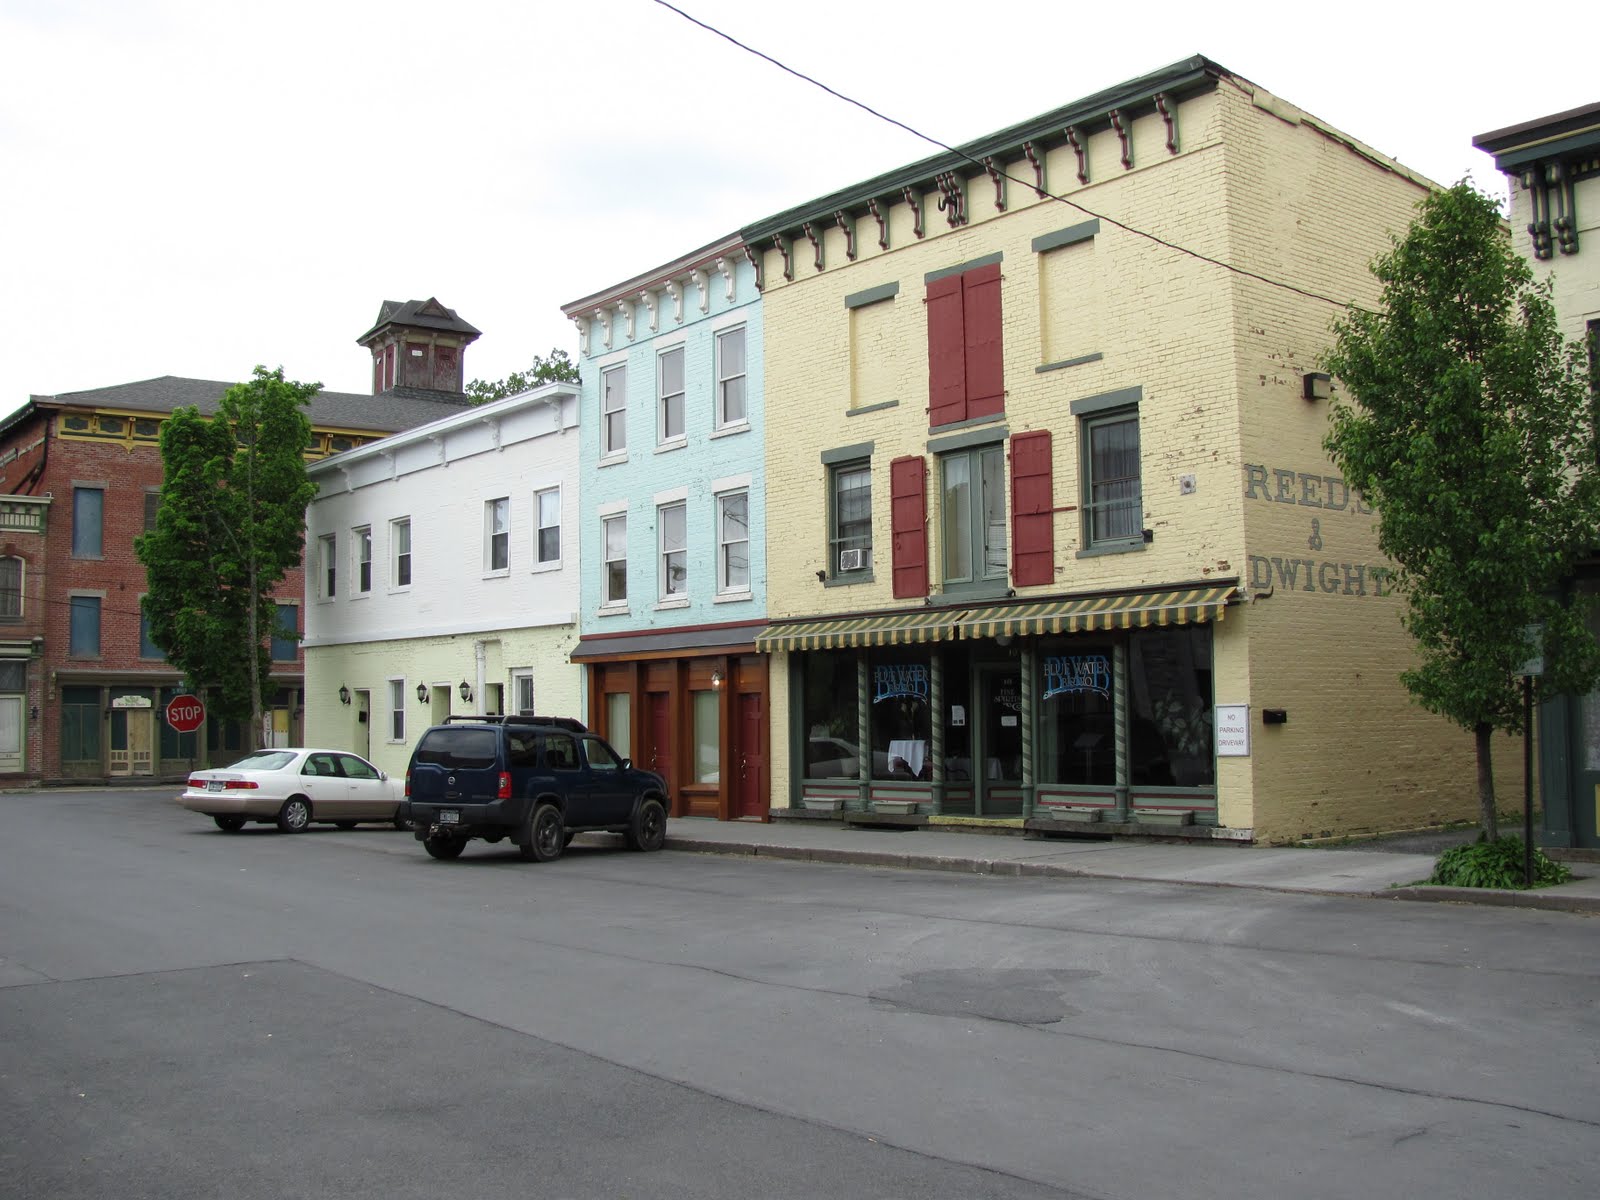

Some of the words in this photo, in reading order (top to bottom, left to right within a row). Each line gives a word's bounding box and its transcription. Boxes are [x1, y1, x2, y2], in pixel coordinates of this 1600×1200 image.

[1308, 517, 1322, 551] &
[1248, 555, 1388, 597] DWIGHT
[898, 670, 929, 682] WATER
[1044, 663, 1070, 676] BLUE
[1075, 661, 1111, 675] WATER
[171, 705, 201, 722] STOP
[1219, 726, 1245, 734] PARKING
[1218, 739, 1245, 747] DRIVEWAY
